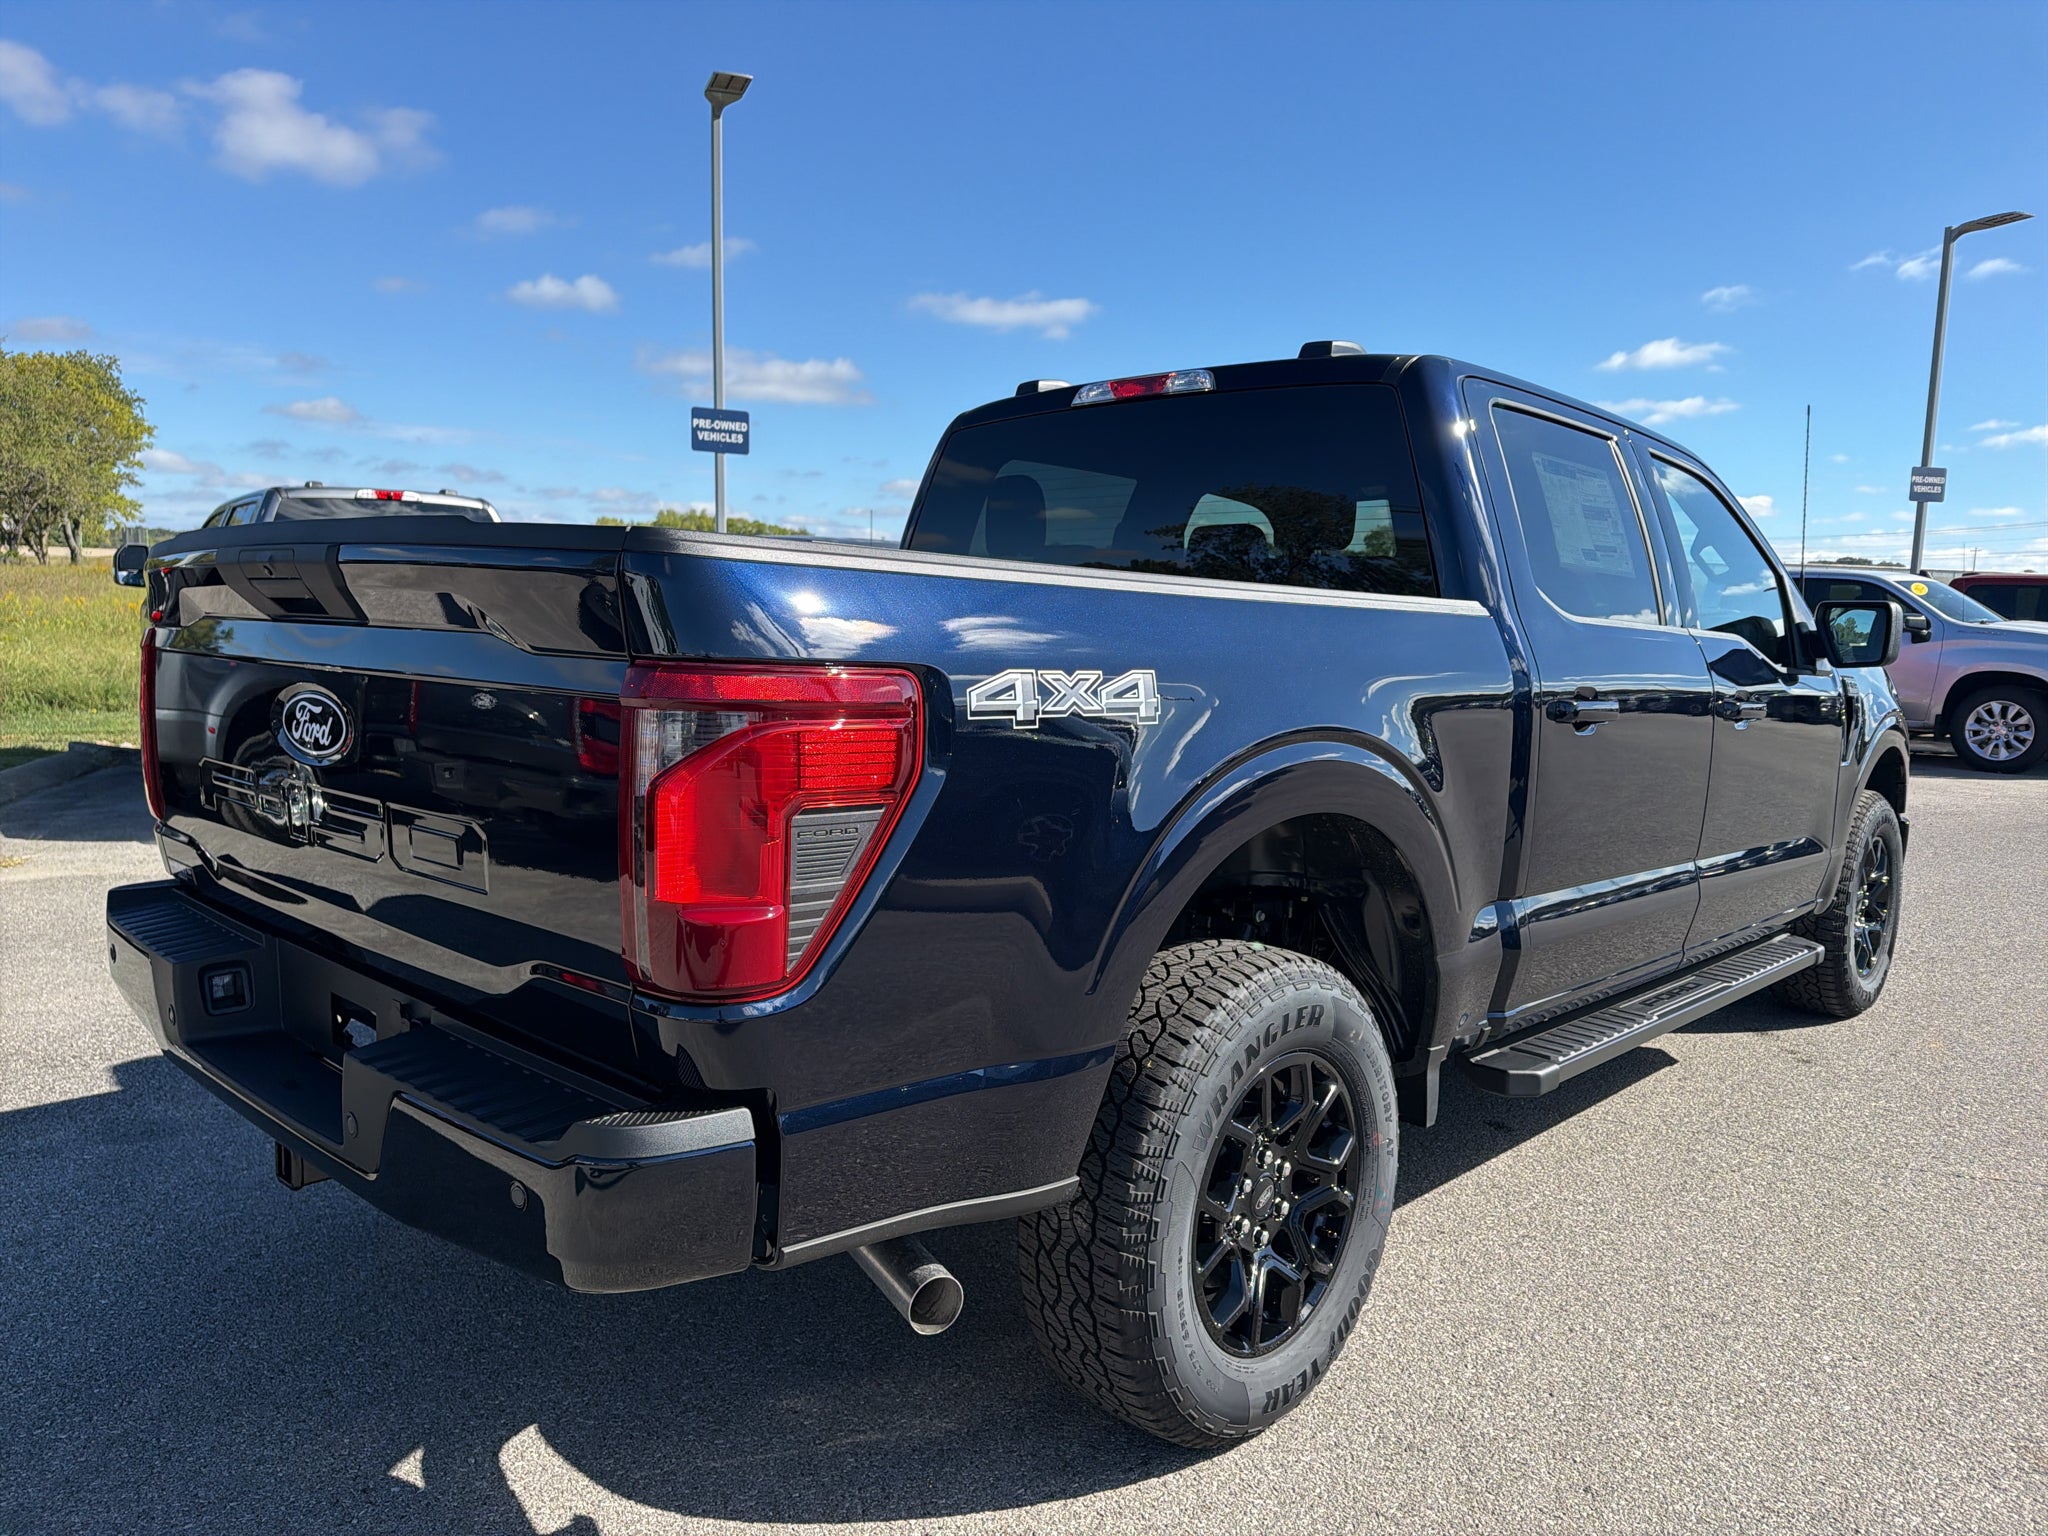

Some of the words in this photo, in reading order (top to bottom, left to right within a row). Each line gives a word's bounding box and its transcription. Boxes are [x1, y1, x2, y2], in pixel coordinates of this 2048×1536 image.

[692, 418, 748, 432] PRE-OWNED
[697, 430, 744, 444] VEHICLES
[1911, 475, 1946, 484] PRE-OWNED
[1913, 485, 1942, 493] VEHICLES
[291, 700, 333, 747] Ford
[796, 827, 859, 839] FORD
[1639, 982, 1703, 1007] FORD
[1192, 1004, 1325, 1152] WRANGLER
